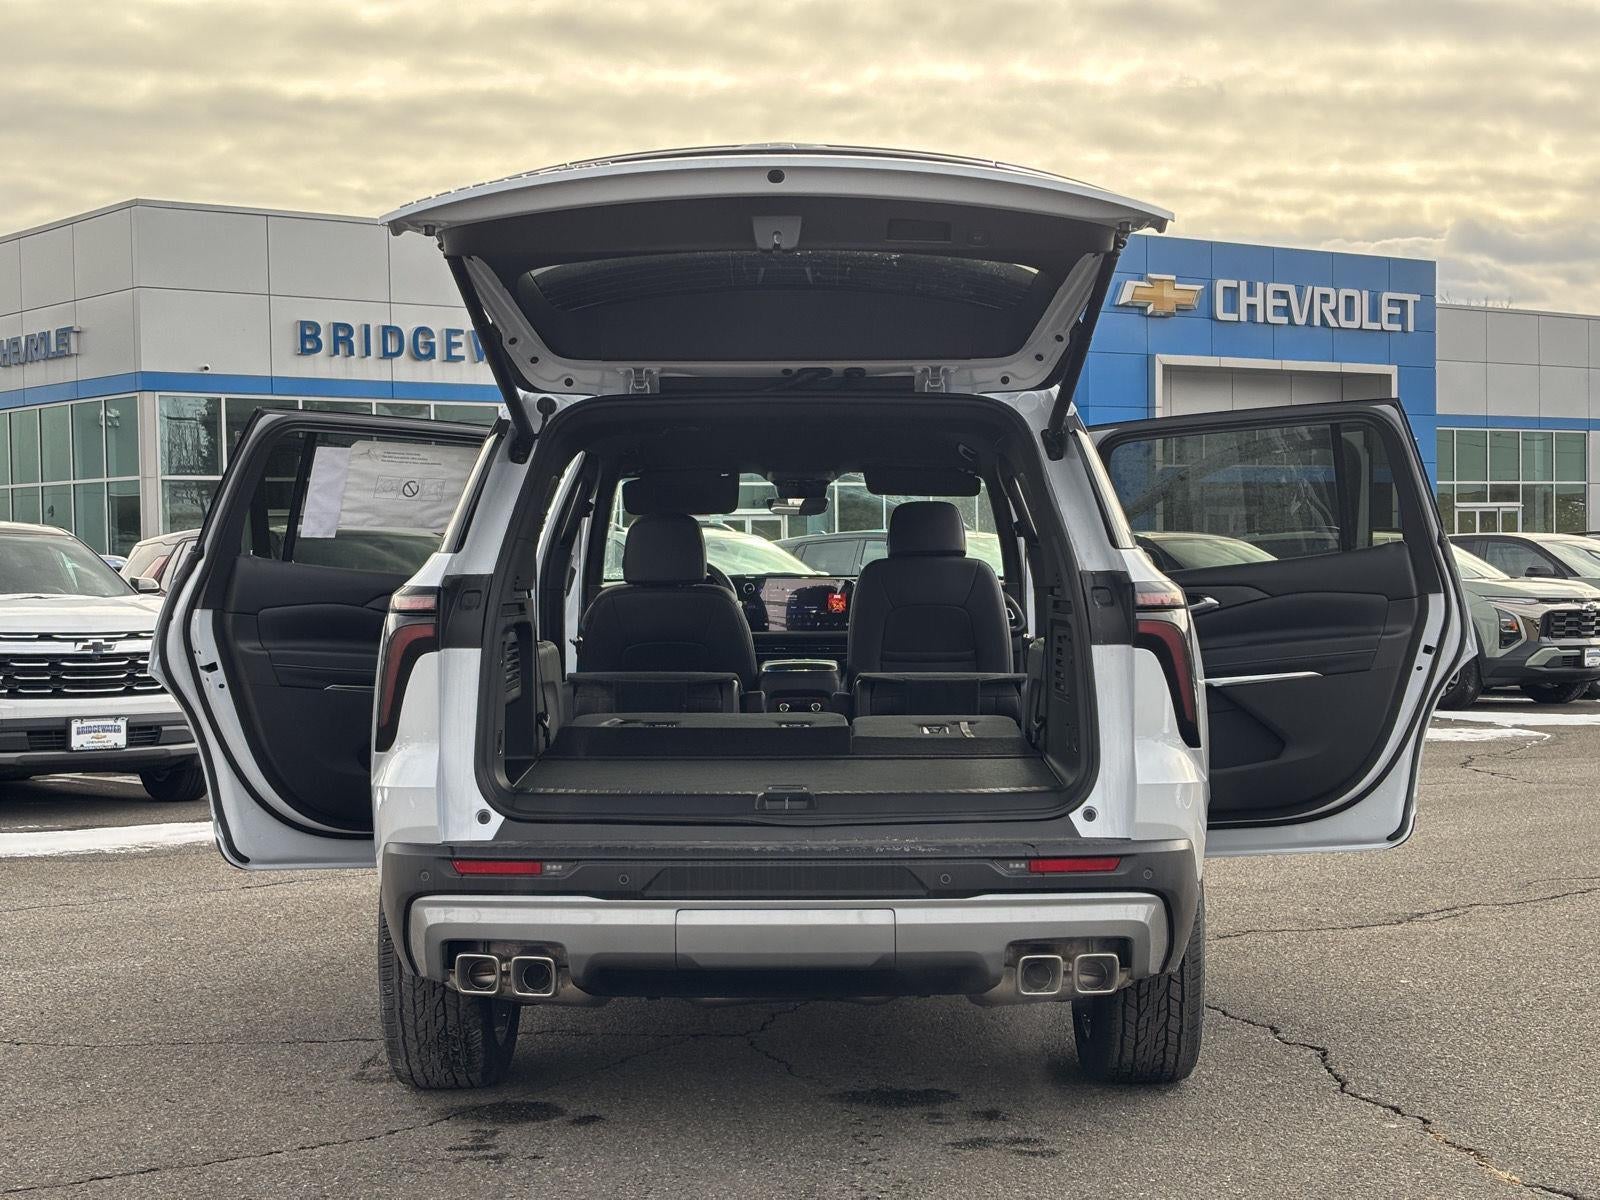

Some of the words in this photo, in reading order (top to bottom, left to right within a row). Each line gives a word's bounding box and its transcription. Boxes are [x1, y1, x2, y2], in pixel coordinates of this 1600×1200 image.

[1215, 279, 1420, 332] CHEVROLET
[0, 325, 80, 368] HEVROLET
[76, 724, 122, 735] BRIDGEWATER
